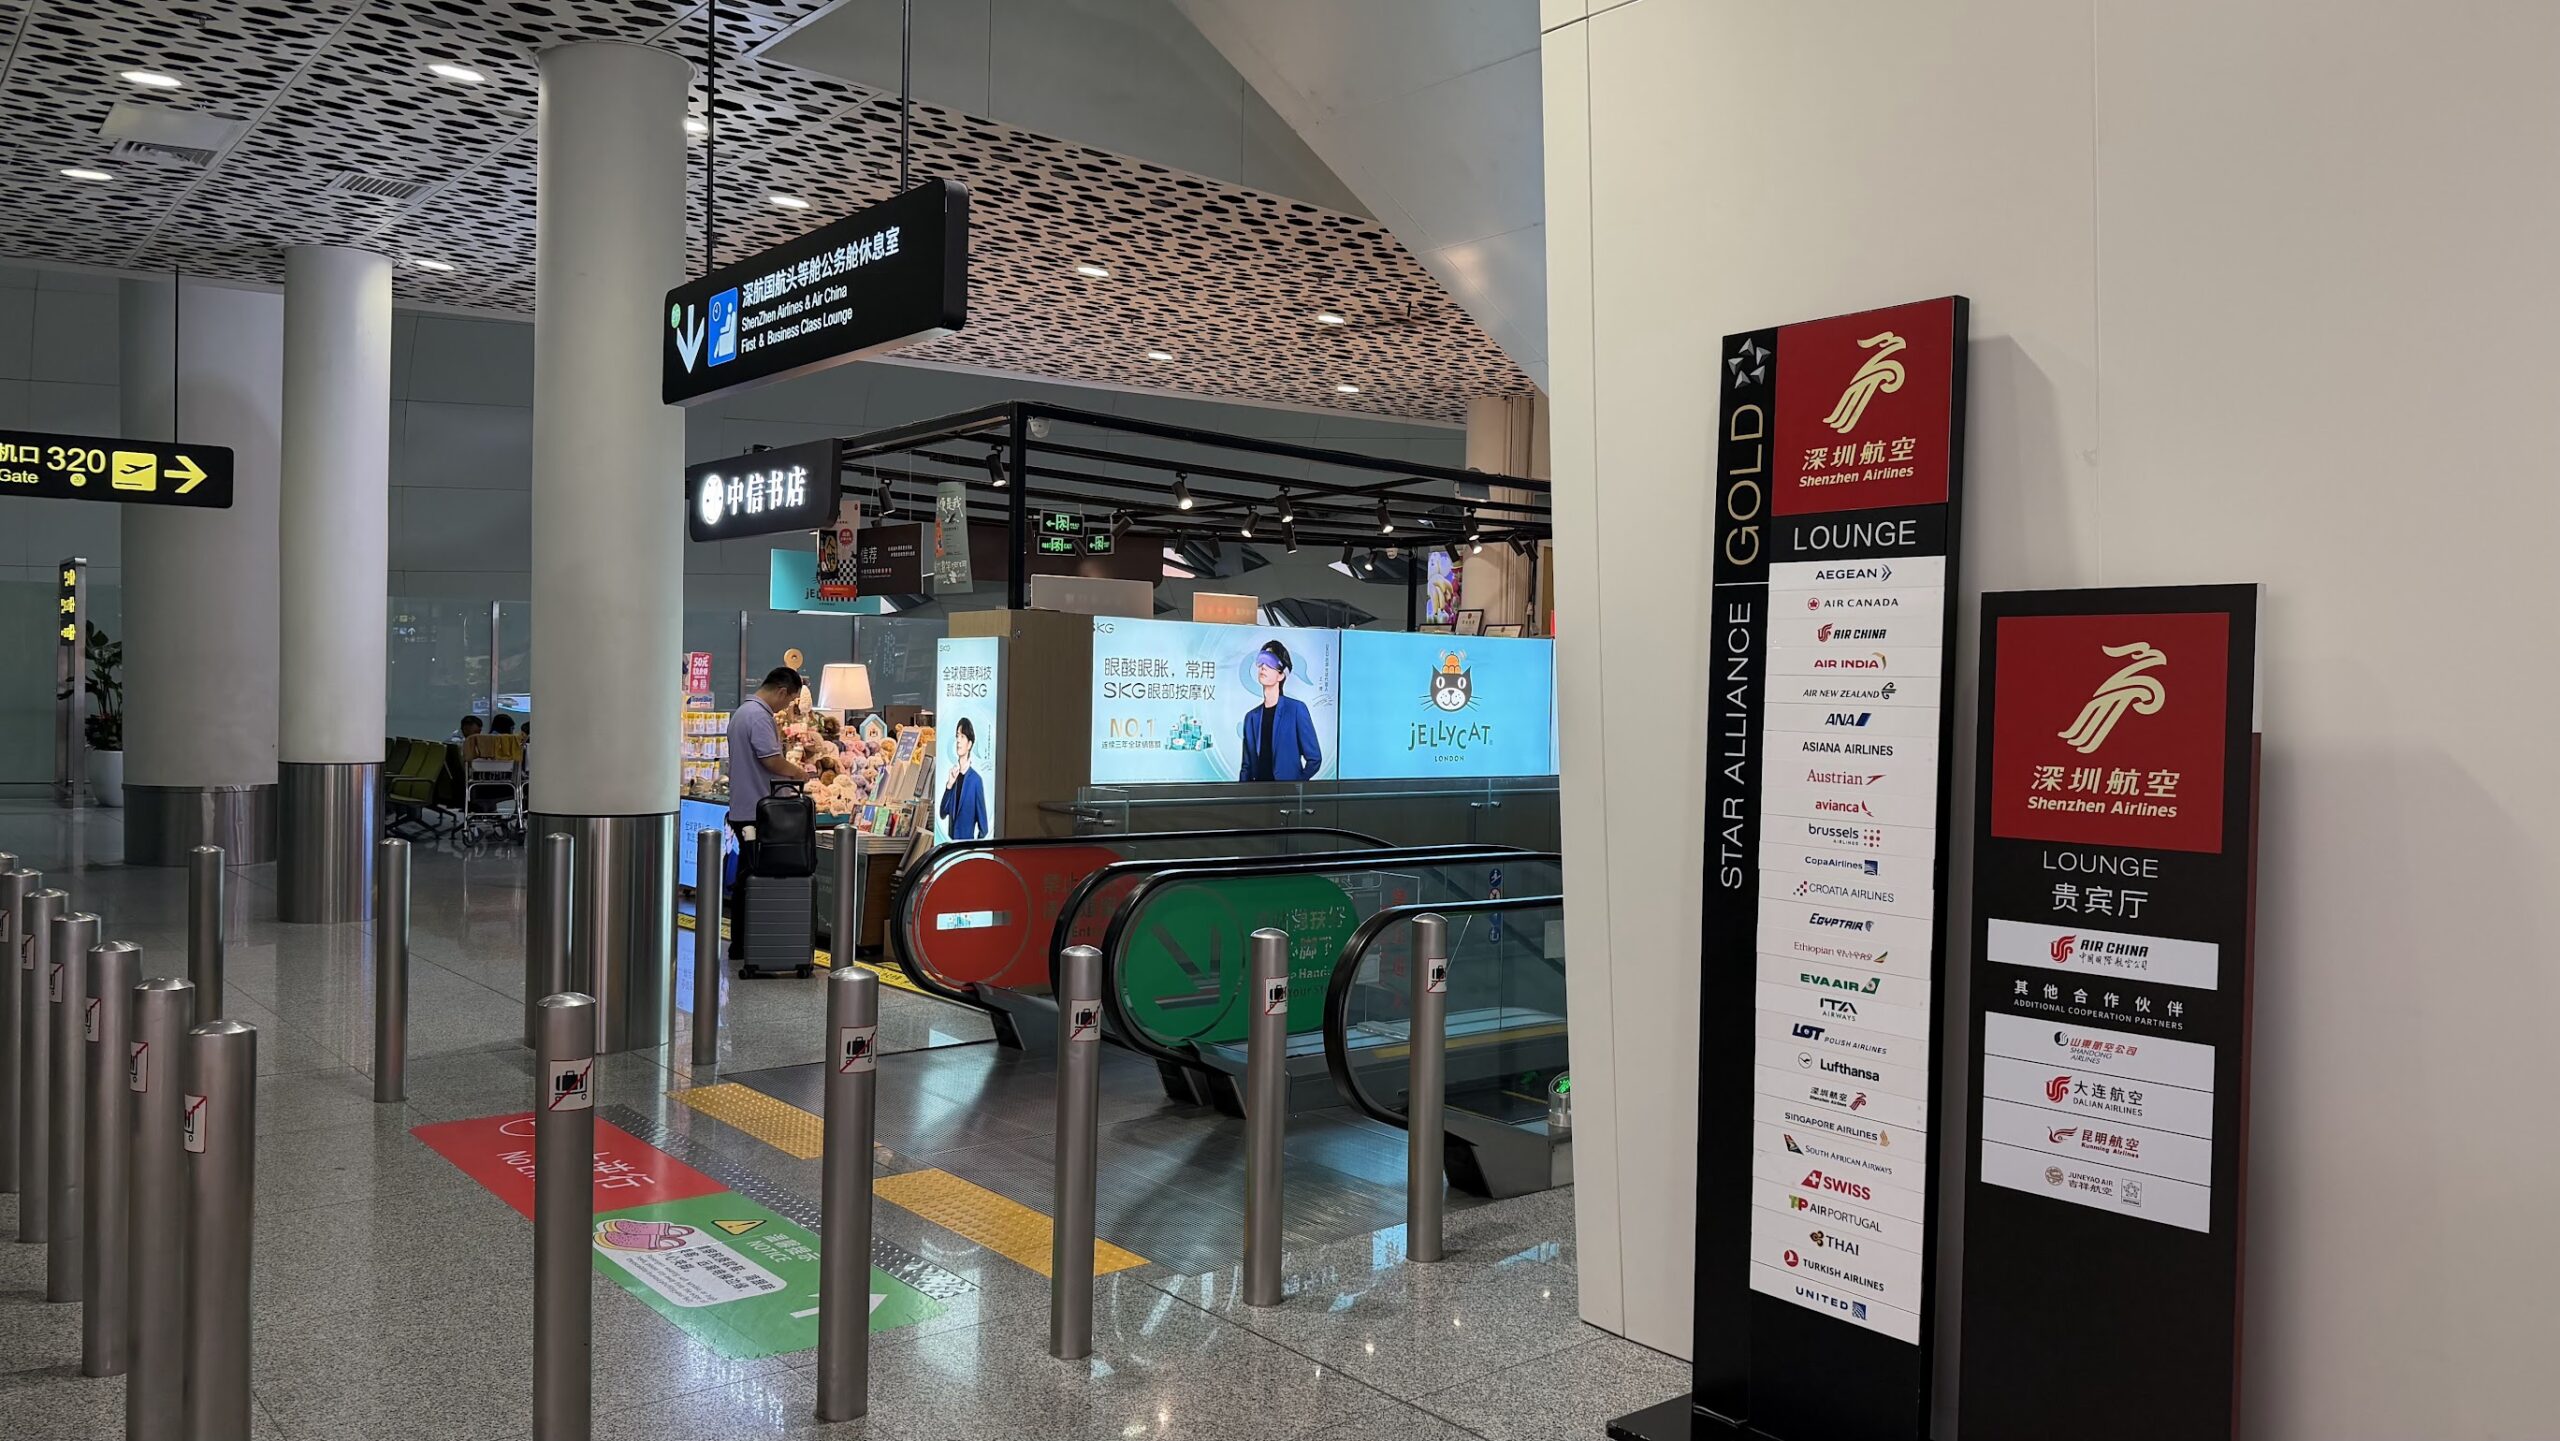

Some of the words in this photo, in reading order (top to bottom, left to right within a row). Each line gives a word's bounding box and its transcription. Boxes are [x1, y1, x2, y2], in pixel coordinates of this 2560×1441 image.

[742, 226, 900, 308] 深航国航头等舱公务舱休息室
[777, 301, 803, 321] Airlines
[804, 296, 811, 309] &
[811, 292, 823, 307] Air
[824, 284, 847, 303] China
[741, 335, 757, 353] First
[758, 335, 765, 347] &
[767, 323, 799, 343] Business
[800, 317, 822, 334] Class
[823, 307, 853, 331] Lounge
[46, 446, 106, 473] 320
[1802, 436, 1916, 471] 深圳航空
[0, 468, 39, 484] Gate
[1726, 404, 1764, 566] GOLD
[1799, 472, 1859, 488] Shenzhen
[1862, 466, 1914, 482] Airlines
[727, 465, 808, 515] 中信书店
[1794, 520, 1917, 551] LOUNGE
[1815, 568, 1877, 580] AEGEAN
[1824, 600, 1844, 608] AIR
[1847, 598, 1899, 607] CANADA
[1833, 630, 1852, 639] AIR
[1853, 629, 1887, 640] CHINA
[1814, 659, 1837, 668] AIR
[1841, 659, 1879, 669] INDIA
[1724, 602, 1750, 785] ALLIANCE
[1803, 689, 1817, 697] AIR
[1819, 690, 1838, 698] NEW
[1840, 690, 1880, 699] ZEALAND
[1825, 713, 1855, 726] ANA
[1802, 741, 1841, 753] ASIANA
[1844, 743, 1893, 756] AIRLINES
[1806, 769, 1863, 785] Austrian
[2031, 765, 2180, 798] 深圳航空
[1815, 800, 1859, 813] avianca
[2028, 796, 2105, 814] Shenzhen
[2111, 801, 2177, 818] Airlines
[1808, 823, 1859, 839] brussels
[1720, 797, 1744, 890] STAR
[2043, 850, 2159, 878] LOUNGE
[1809, 882, 1849, 897] CROATIA
[1850, 889, 1895, 903] AIRLINES
[2051, 883, 2149, 919] 贵宾厅
[1809, 913, 1863, 931] EGYPTAIR
[1793, 941, 1834, 955] Ethiopian
[2080, 939, 2104, 952] AIR
[2106, 942, 2149, 957] CHINA
[1800, 973, 1830, 987] EVA
[1829, 979, 1859, 991] AIR
[1819, 998, 1858, 1015] ITA
[2014, 979, 2184, 1017] 其他合作伙伴
[1822, 1010, 1856, 1022] AIRWAYS
[2014, 998, 2065, 1014] ADDITIONAL
[2068, 1006, 2132, 1023] COOPERATION
[2134, 1016, 2183, 1030] PARTNERS
[1792, 1023, 1825, 1041] LOT
[1824, 1036, 1851, 1048] POLISH
[1852, 1042, 1887, 1055] AIRLINES
[2070, 1047, 2112, 1060] SHANDONG
[2070, 1055, 2100, 1065] AIRLINES
[1820, 1058, 1880, 1082] Lufthansa
[2074, 1080, 2143, 1106] 大连航空
[2073, 1097, 2103, 1110] DALIAN
[2104, 1103, 2143, 1117] AIRLINES
[1784, 1111, 1835, 1131] SINGAPORE
[1836, 1124, 1878, 1141] AIRLINES
[2081, 1129, 2139, 1152] 昆明航空
[2081, 1142, 2110, 1154] Kunming
[2112, 1148, 2139, 1158] Airlines
[1805, 1145, 1829, 1158] SOUTH
[1830, 1152, 1861, 1166] AFRICAN
[1862, 1160, 1892, 1175] AIRWAYS
[1823, 1176, 1871, 1200] SWISS
[2068, 1171, 2100, 1184] JUNEYAO
[2101, 1179, 2114, 1187] AIR
[2068, 1180, 2113, 1197] 吉祥航空
[747, 1240, 792, 1263] NOTICE
[1826, 1235, 1859, 1256] THAI
[1803, 1258, 1841, 1278] TURKISH
[1843, 1271, 1884, 1292] AIRLINES
[1795, 1286, 1848, 1310] UNITED
